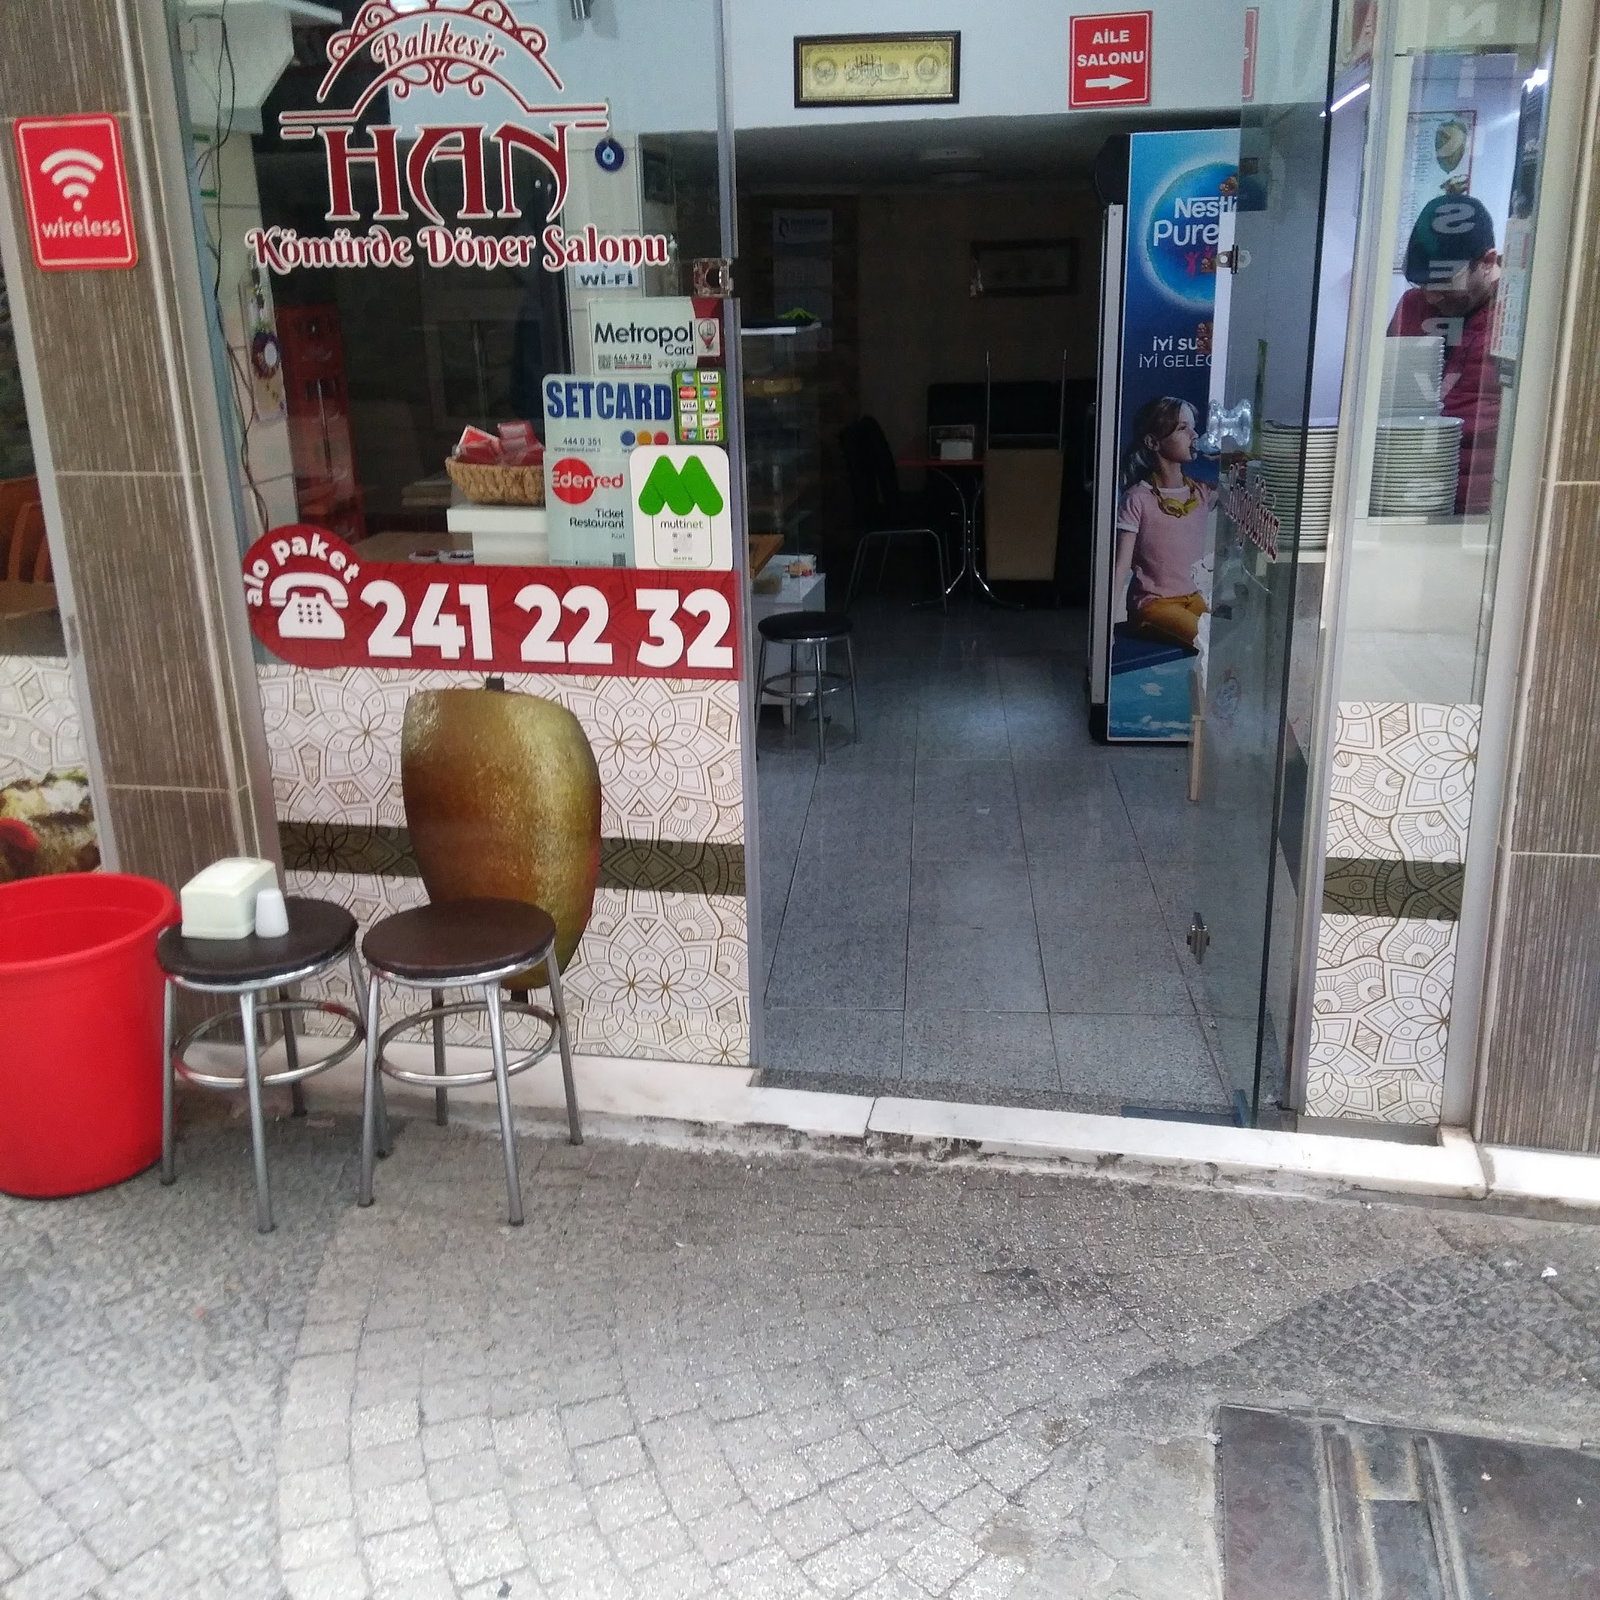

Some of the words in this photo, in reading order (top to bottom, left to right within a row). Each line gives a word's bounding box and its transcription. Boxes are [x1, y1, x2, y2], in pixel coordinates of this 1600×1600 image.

[371, 19, 506, 68] Balıkesir
[1092, 28, 1130, 44] AİLE
[1077, 51, 1145, 67] SALONU
[318, 122, 570, 225] HAN
[41, 215, 121, 238] wireless
[1153, 219, 1219, 246] Pure
[245, 224, 414, 275] Kömürde
[417, 227, 536, 269] Döner
[542, 223, 669, 272] Salonu
[594, 321, 694, 347] Metropol
[664, 344, 694, 355] Card
[1139, 354, 1159, 368] İYİ
[546, 380, 672, 421] SETCARD
[563, 437, 578, 446] 444
[552, 470, 624, 489] Edenred
[569, 516, 625, 529] Restaurant
[595, 508, 624, 518] Ticket
[660, 518, 704, 529] multinet
[243, 559, 270, 607] alo
[271, 533, 360, 584] paket
[360, 580, 493, 661] 241
[514, 584, 613, 664] 22
[635, 588, 734, 669] 32
